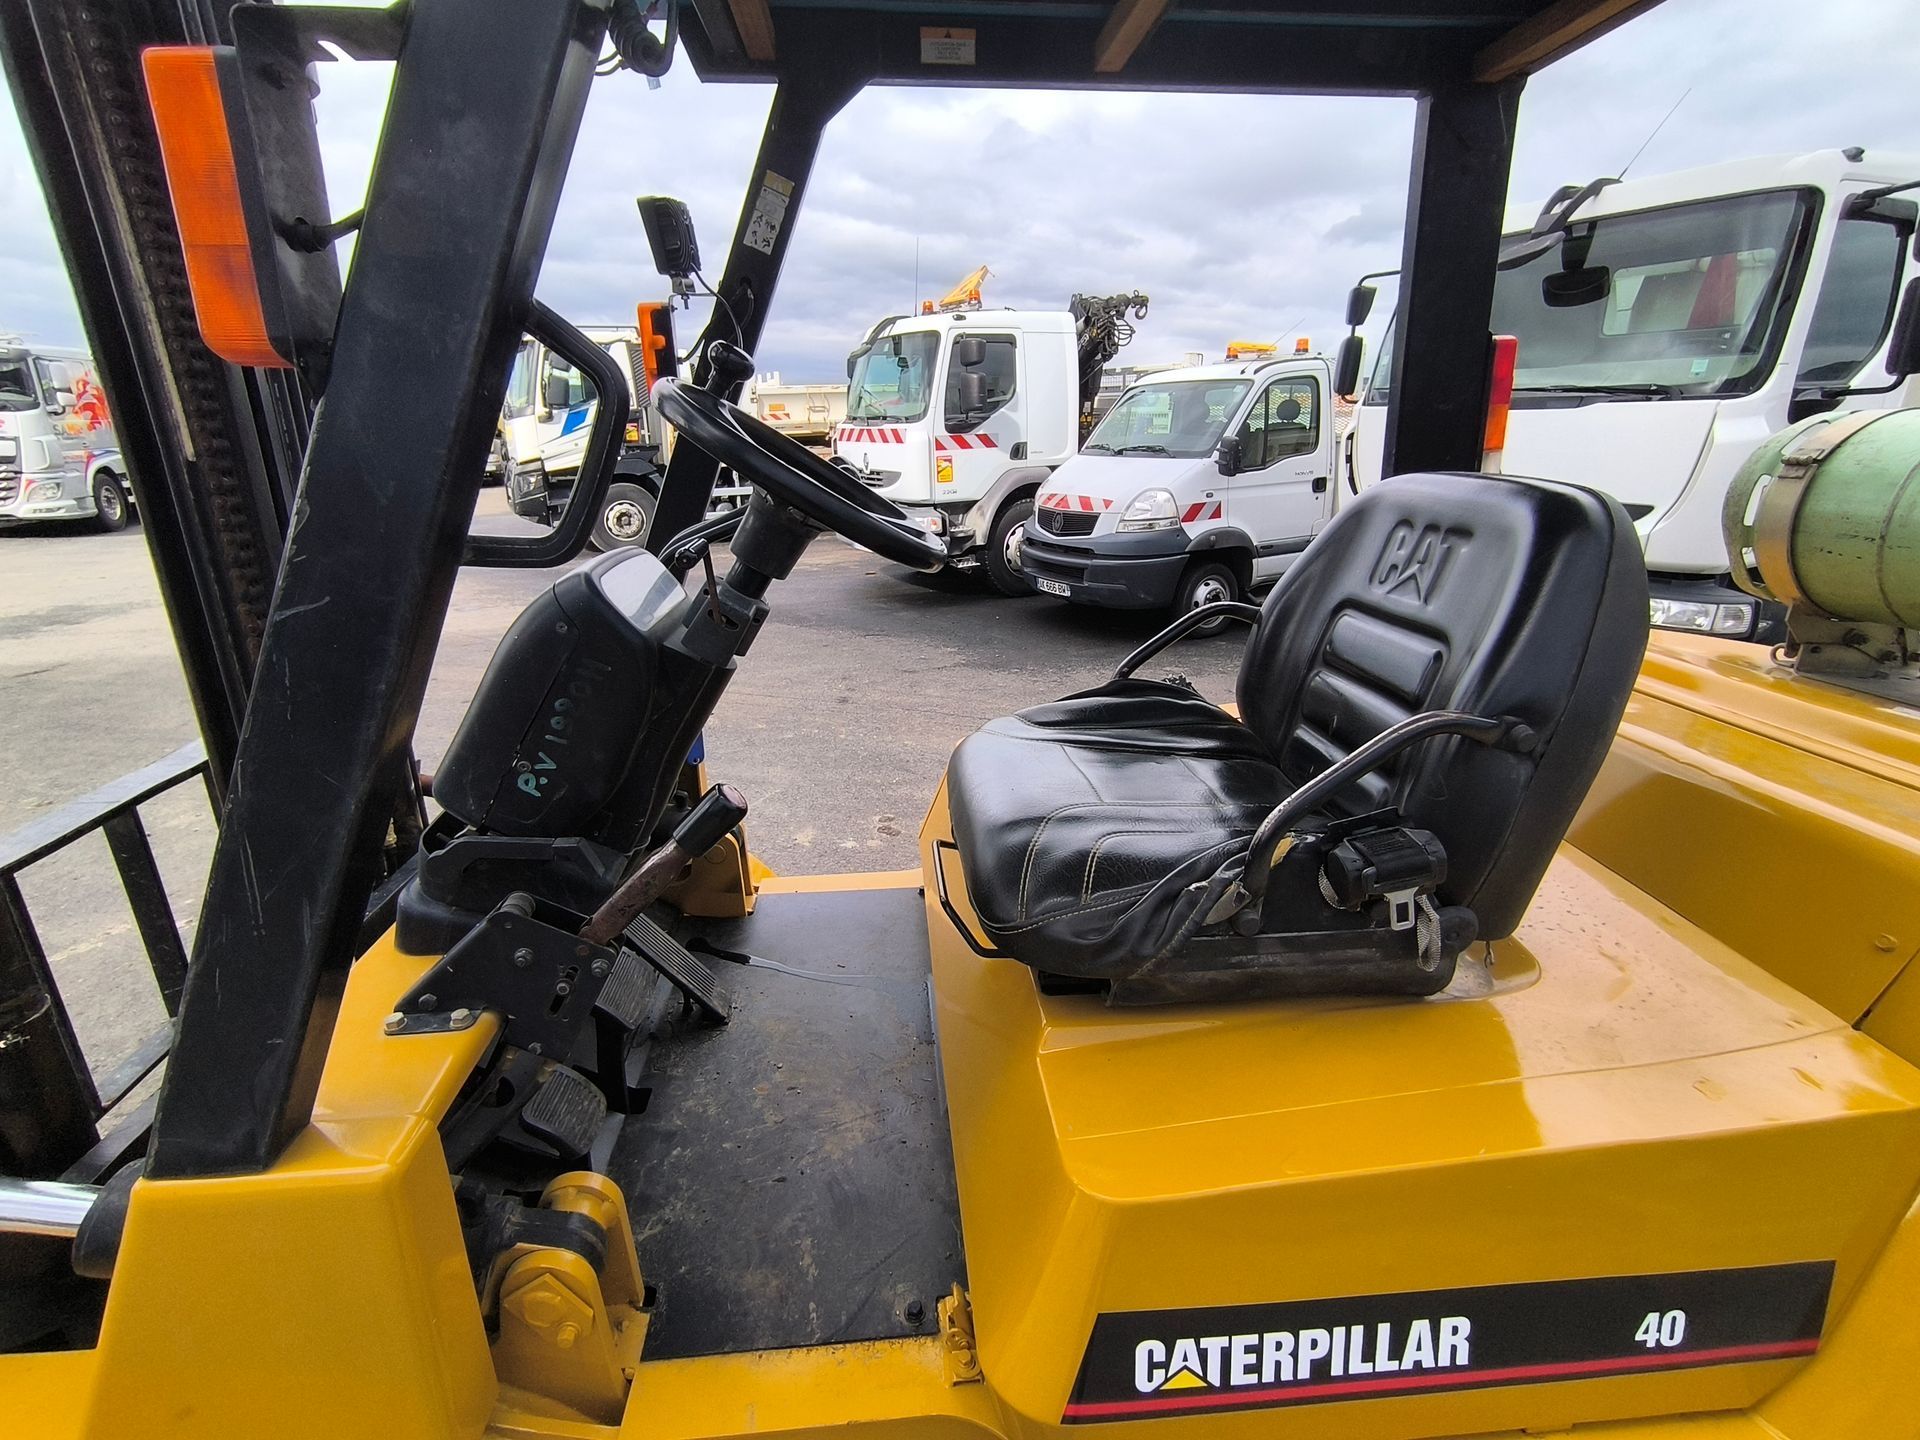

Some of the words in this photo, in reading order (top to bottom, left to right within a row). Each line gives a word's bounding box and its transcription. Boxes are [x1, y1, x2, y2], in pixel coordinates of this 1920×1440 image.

[1368, 518, 1474, 606] CAT
[1134, 1315, 1471, 1393] CATERPILLAR
[1633, 1309, 1687, 1348] 40
